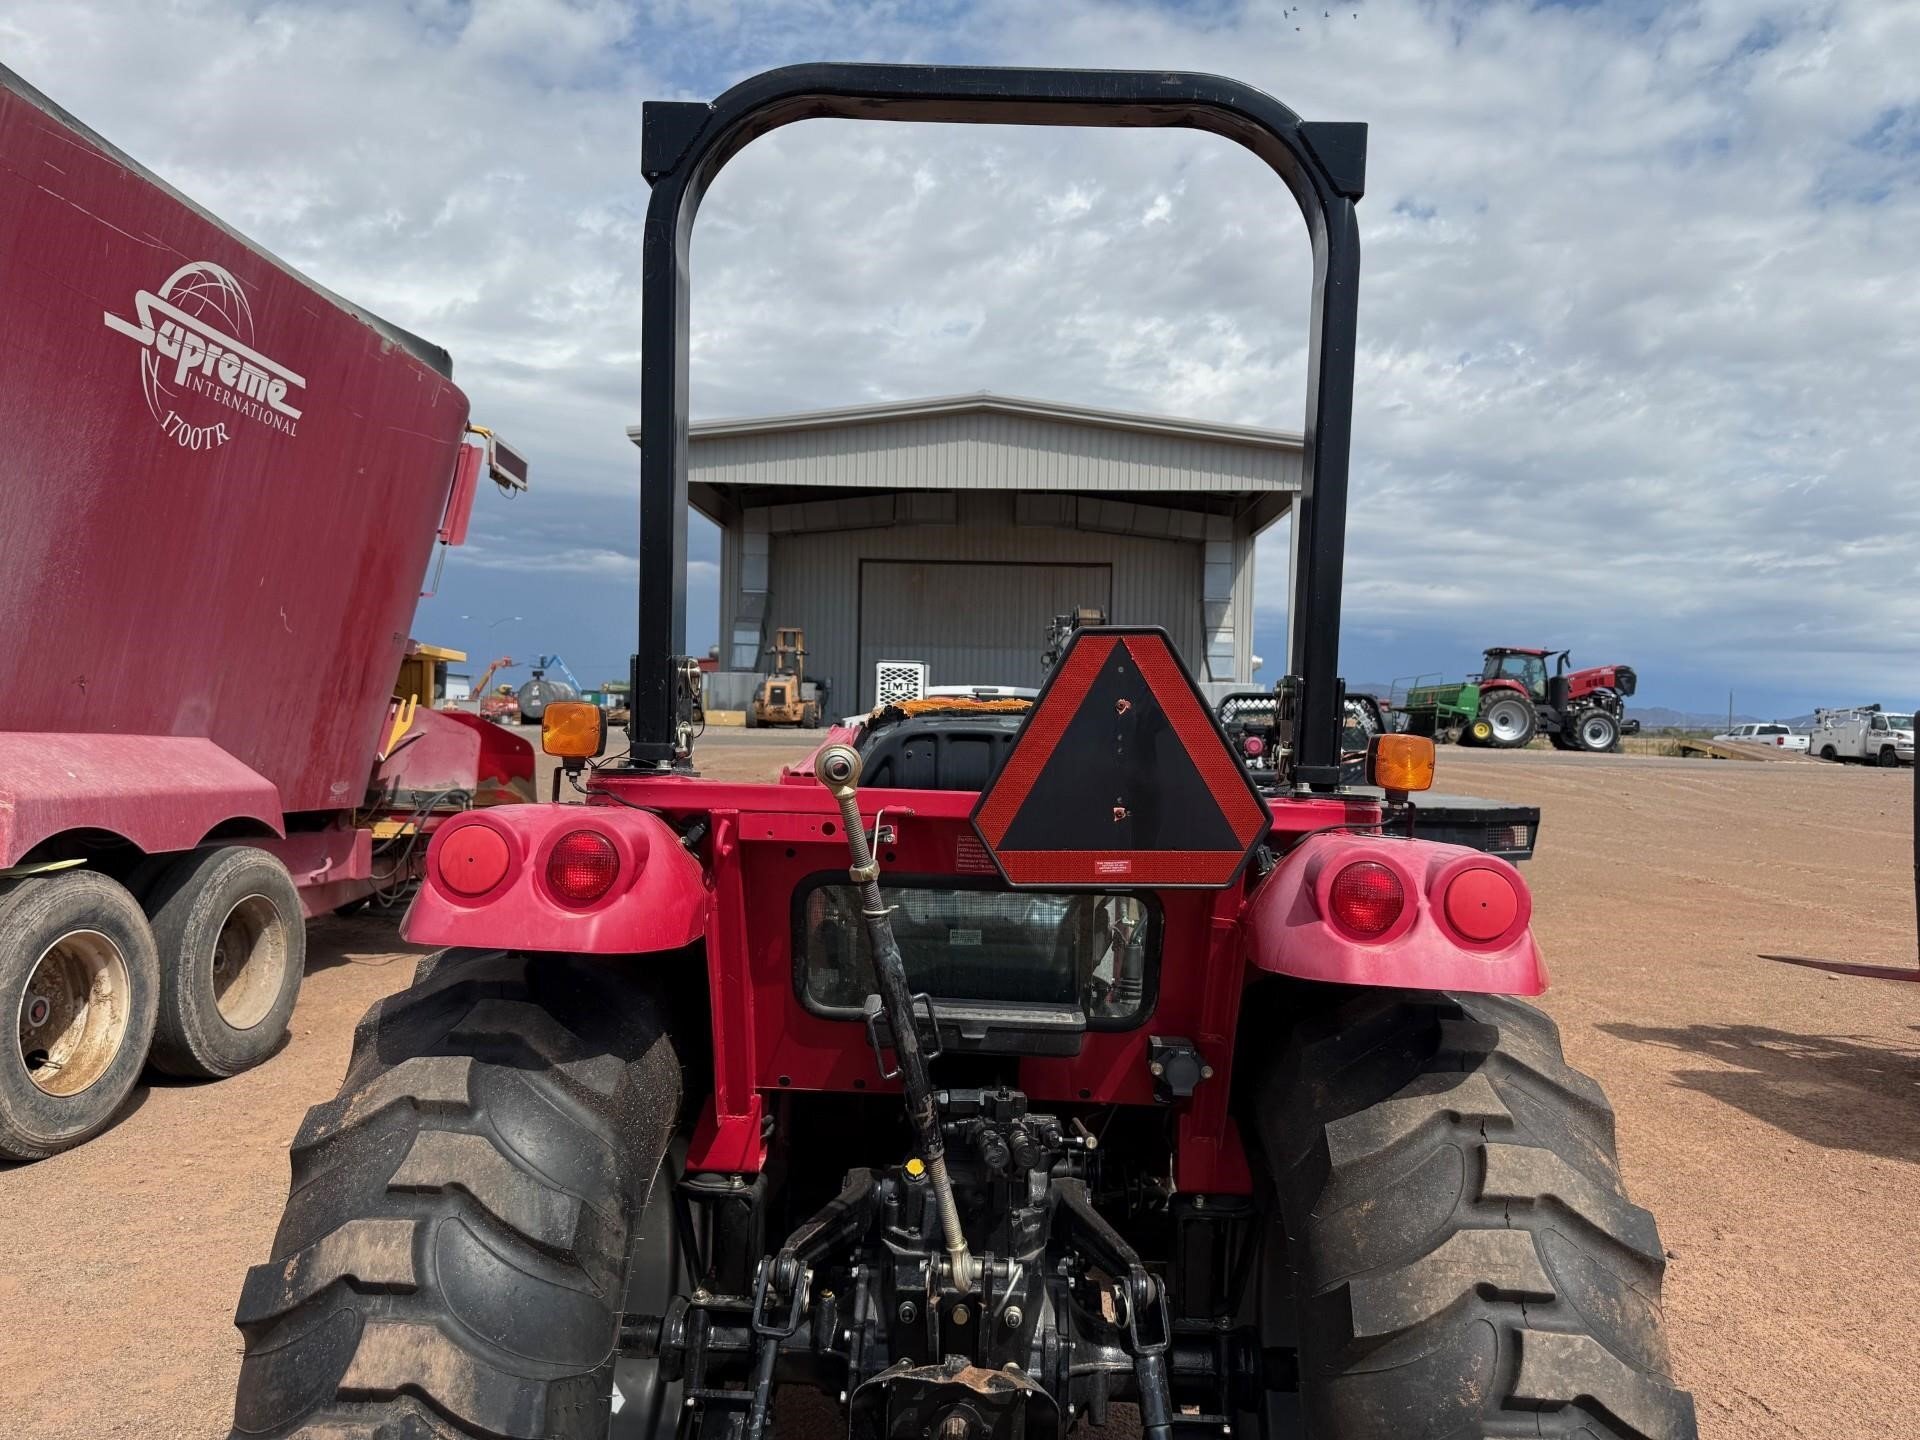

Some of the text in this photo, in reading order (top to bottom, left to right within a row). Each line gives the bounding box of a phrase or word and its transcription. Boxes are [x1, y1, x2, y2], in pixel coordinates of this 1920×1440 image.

[104, 289, 306, 420] Supreme
[160, 410, 231, 450] 1700TR
[185, 373, 297, 437] INTERNATIONAL
[887, 682, 912, 691] IMT
